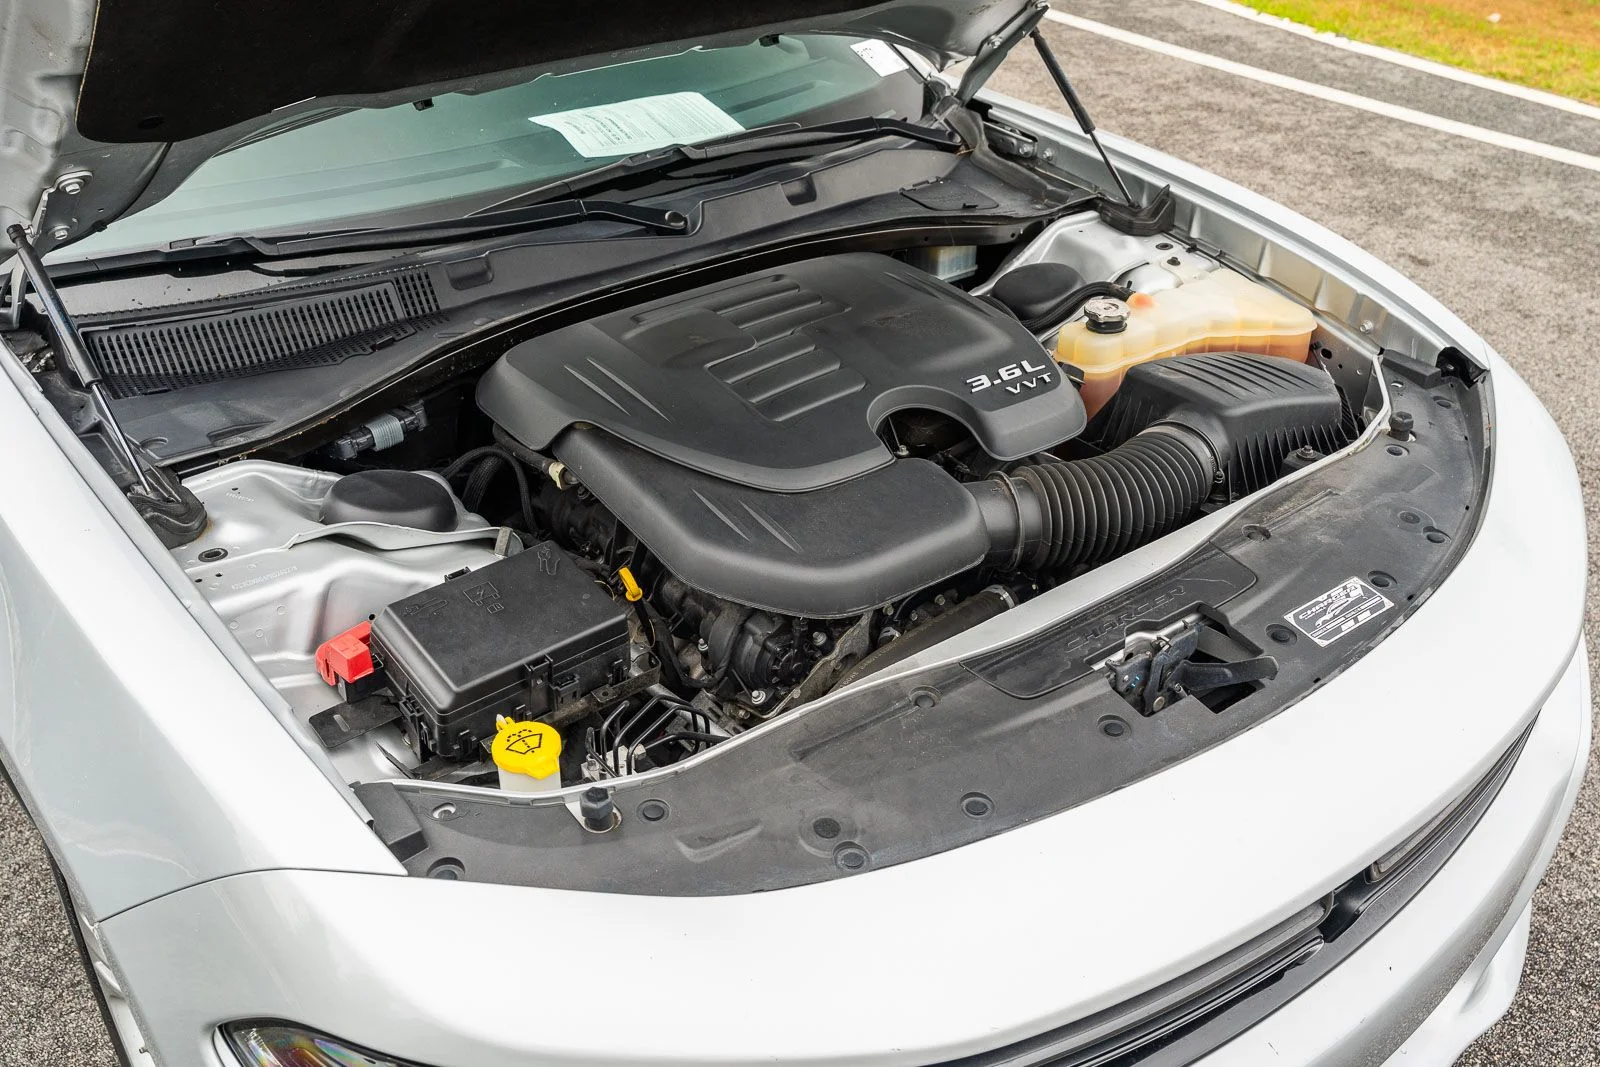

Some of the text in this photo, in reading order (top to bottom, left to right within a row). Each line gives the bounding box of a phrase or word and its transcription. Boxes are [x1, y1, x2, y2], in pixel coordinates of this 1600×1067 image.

[966, 359, 1046, 393] 3.6L
[1005, 372, 1051, 394] VVT
[1065, 584, 1186, 654] CHARGER
